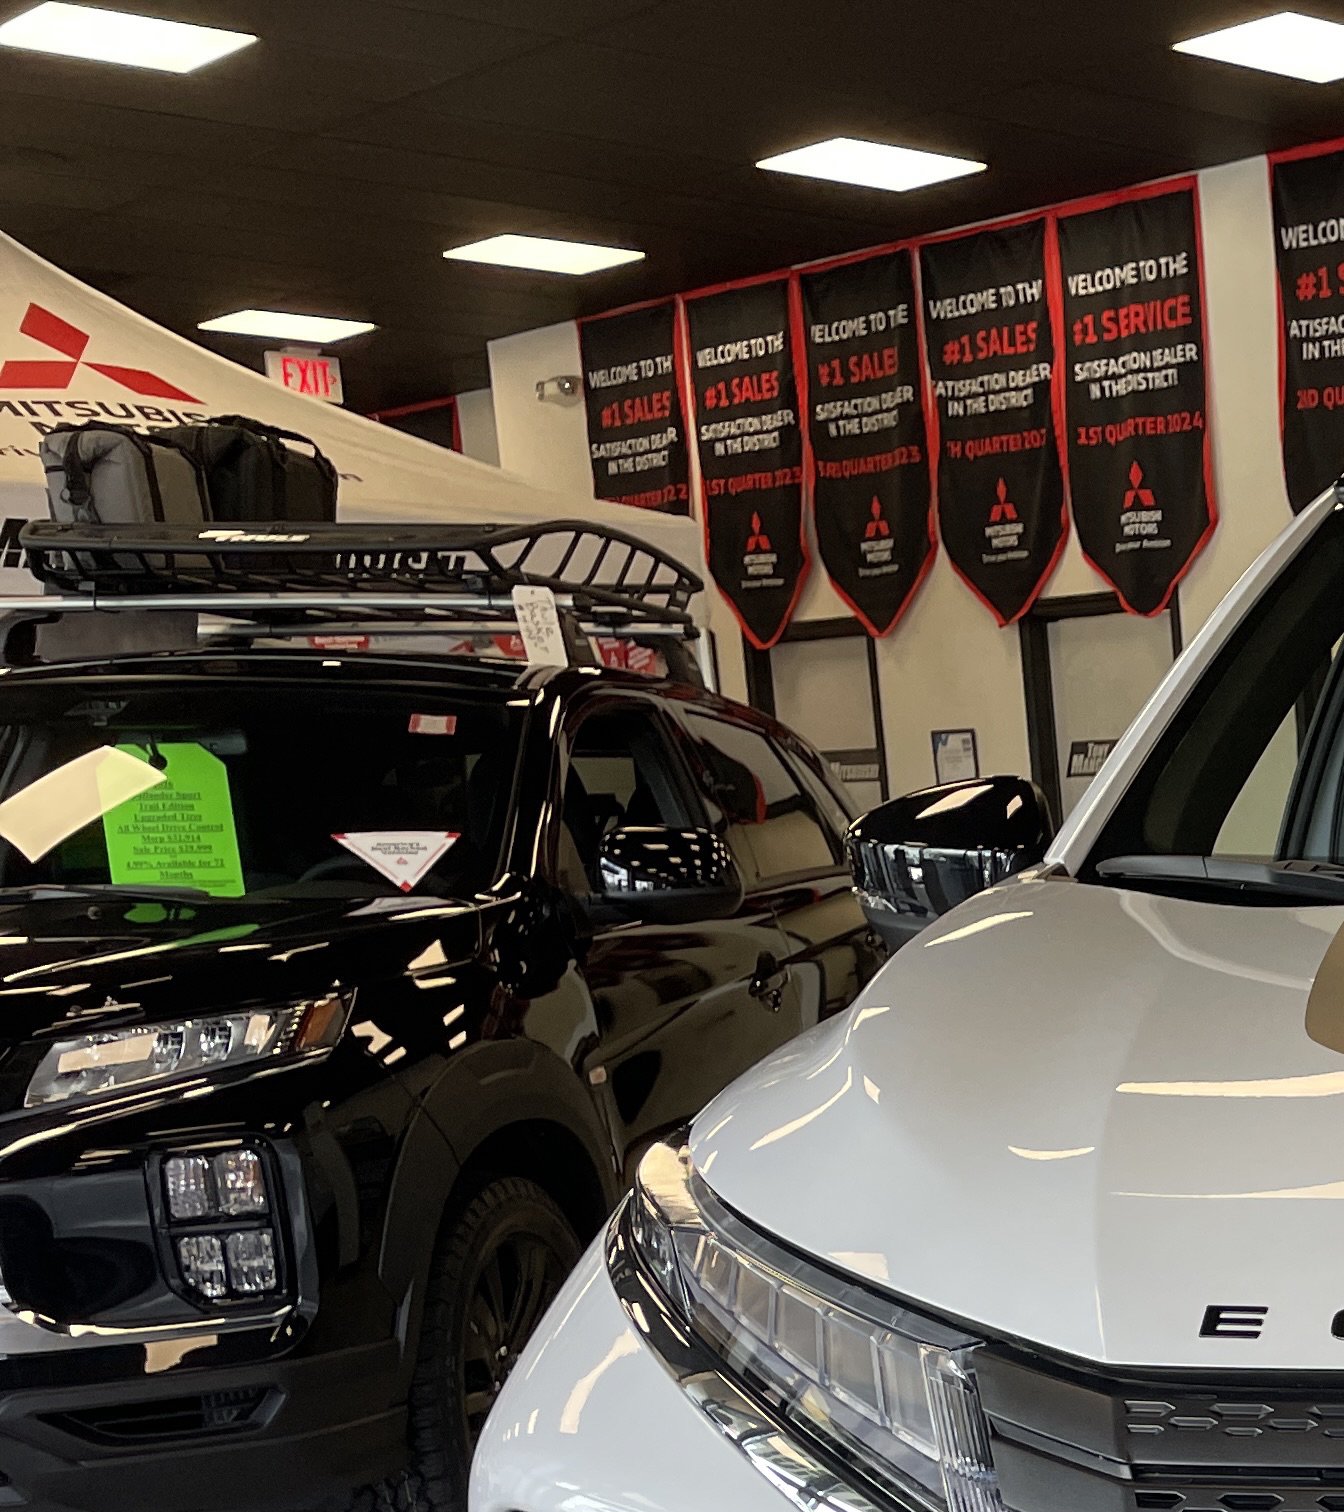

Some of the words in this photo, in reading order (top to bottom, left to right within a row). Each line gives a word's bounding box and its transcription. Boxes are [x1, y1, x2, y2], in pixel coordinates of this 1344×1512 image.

[1139, 259, 1158, 283] TO
[1159, 251, 1189, 277] THE
[1296, 266, 1332, 300] #1
[928, 287, 996, 320] WELCOME
[1000, 284, 1016, 308] TO
[1102, 294, 1192, 342] SERVICE
[869, 310, 886, 333] TO
[751, 335, 766, 358] TO
[942, 335, 974, 365] #1
[976, 320, 1038, 360] SALES
[1302, 341, 1319, 360] IN
[282, 356, 331, 397] EXIT
[589, 362, 638, 390] WELCOME
[639, 358, 654, 378] TO
[818, 358, 845, 387] #1
[704, 381, 730, 410] #1
[731, 369, 780, 407] SALES
[0, 399, 208, 427] MITSUBIS
[601, 400, 622, 429] #1
[623, 390, 672, 424] SALES
[948, 400, 964, 418] IN
[838, 418, 861, 436] THE
